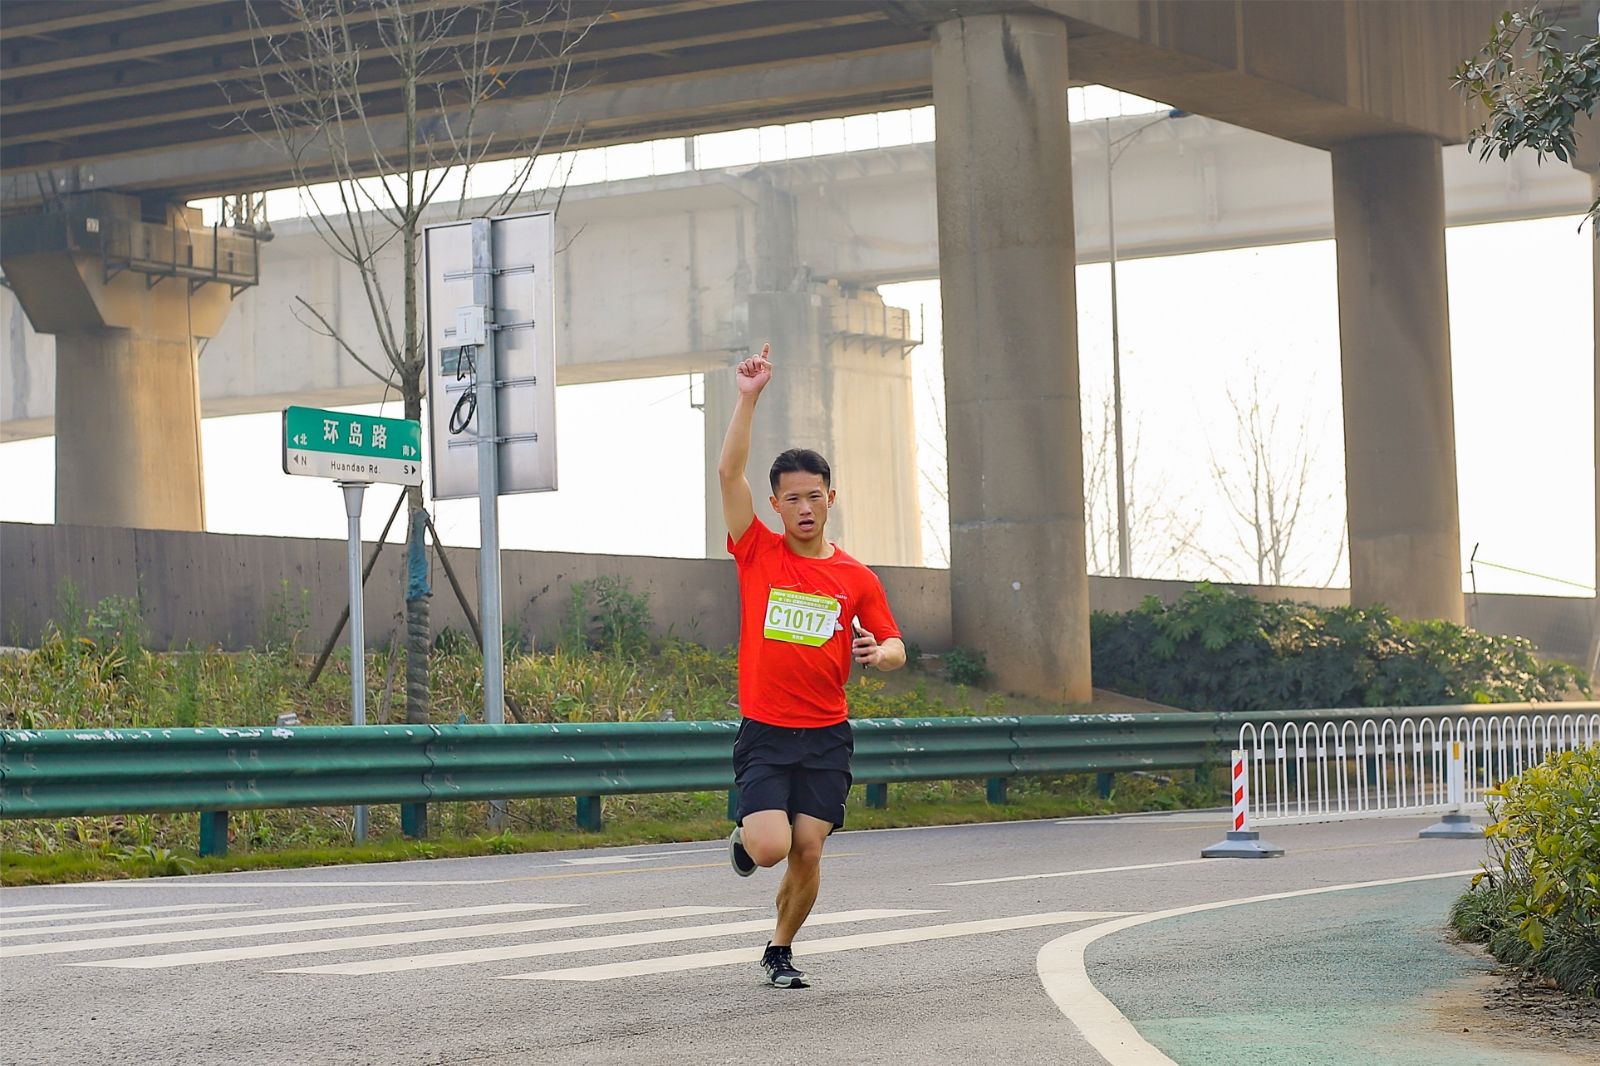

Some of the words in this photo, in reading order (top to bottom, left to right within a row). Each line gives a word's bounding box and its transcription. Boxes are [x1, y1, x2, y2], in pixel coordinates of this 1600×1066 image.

[300, 433, 308, 446] 北
[323, 419, 387, 449] 环岛路
[301, 455, 307, 466] N
[331, 461, 365, 473] Huandao
[404, 465, 409, 475] S
[769, 605, 826, 633] C1017
